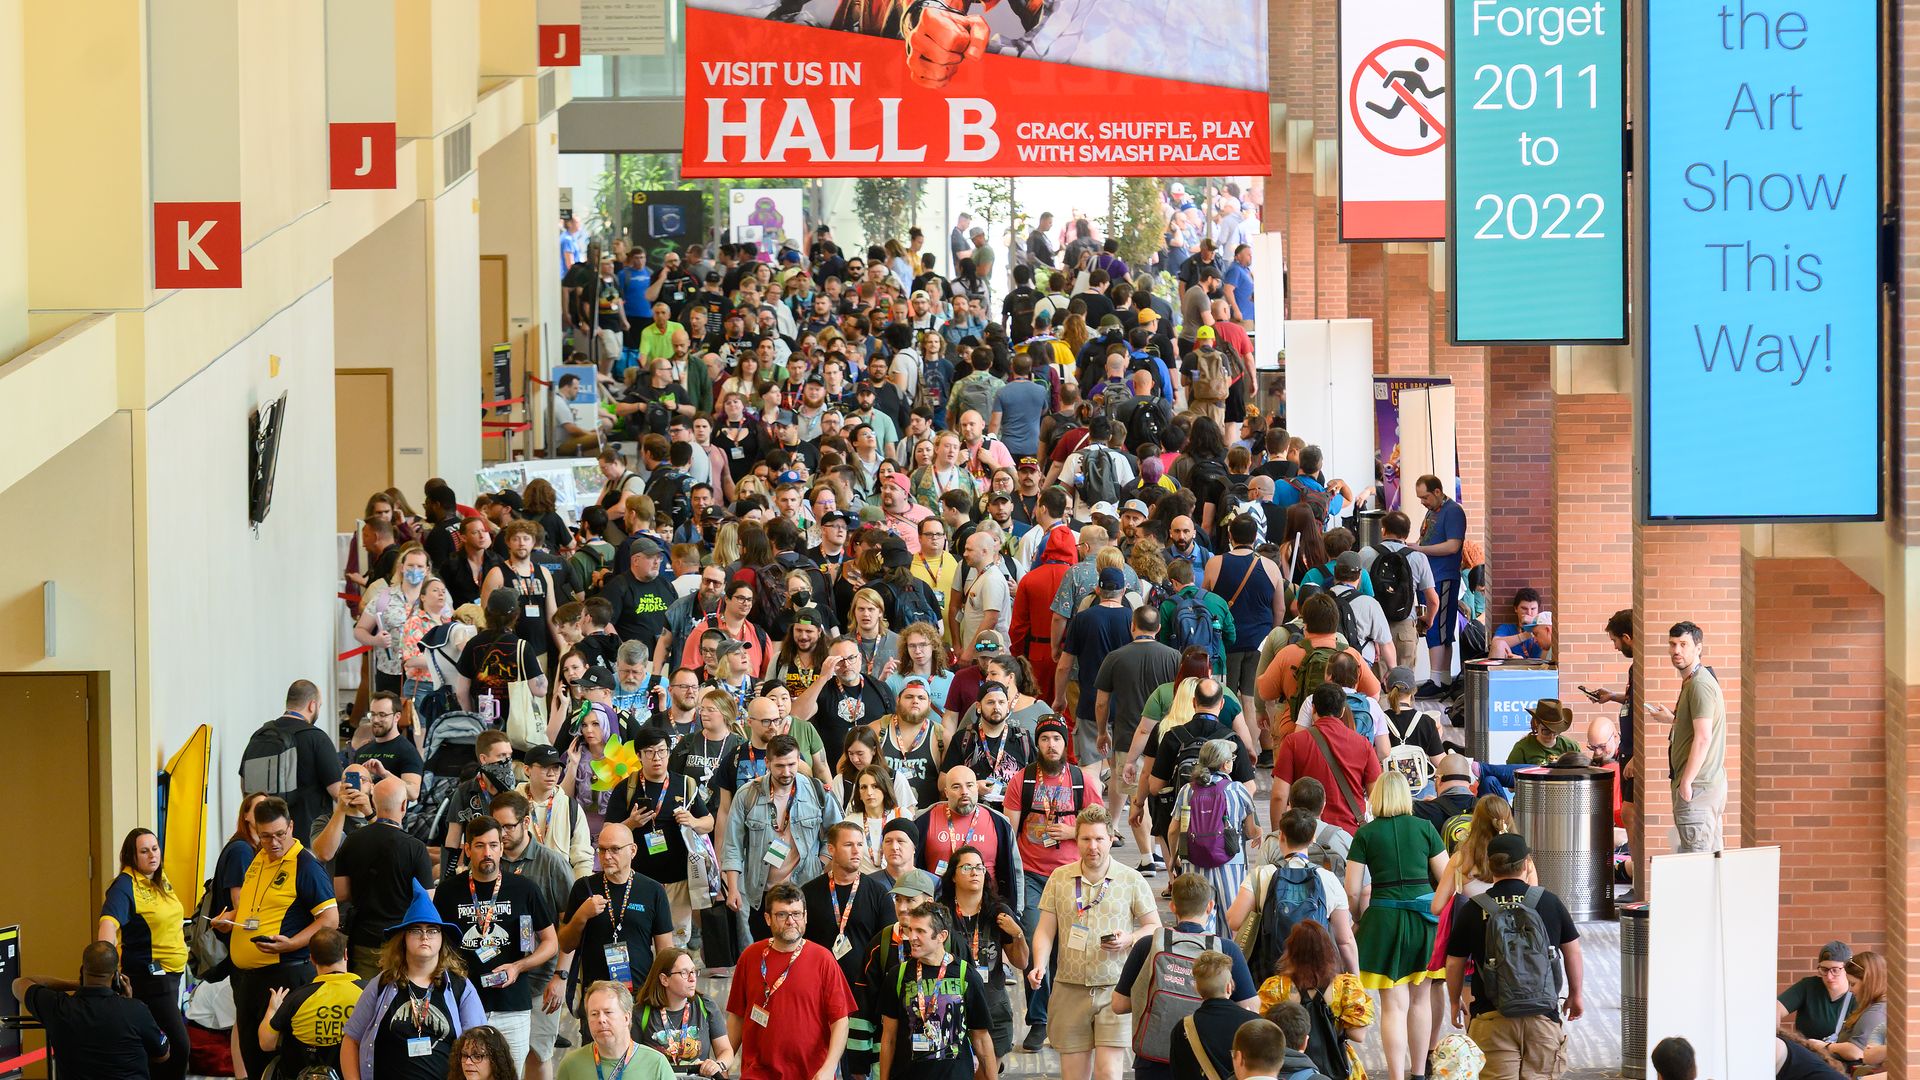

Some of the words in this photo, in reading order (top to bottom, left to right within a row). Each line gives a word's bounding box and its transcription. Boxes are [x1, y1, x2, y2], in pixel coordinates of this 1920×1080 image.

[554, 33, 566, 59] J
[1472, 1, 1606, 47] Forget
[1717, 0, 1808, 51] the
[702, 62, 778, 86] VISIT
[784, 62, 824, 86] US
[829, 62, 862, 86] IN
[1471, 64, 1597, 110] 2011
[1724, 82, 1803, 131] Art
[703, 97, 928, 163] HALL
[944, 98, 1002, 162] B
[1016, 121, 1095, 142] CRACK,
[1098, 121, 1198, 143] SHUFFLE,
[1202, 121, 1255, 140] PLAY
[1016, 144, 1075, 162] WITH
[1078, 144, 1155, 162] SMASH
[1158, 143, 1241, 162] PALACE
[1518, 131, 1559, 167] to
[354, 136, 372, 176] J
[1683, 159, 1847, 213] Show
[1473, 193, 1605, 240] 2022
[177, 220, 220, 271] K
[1704, 239, 1823, 293] This
[1693, 323, 1834, 386] Way!
